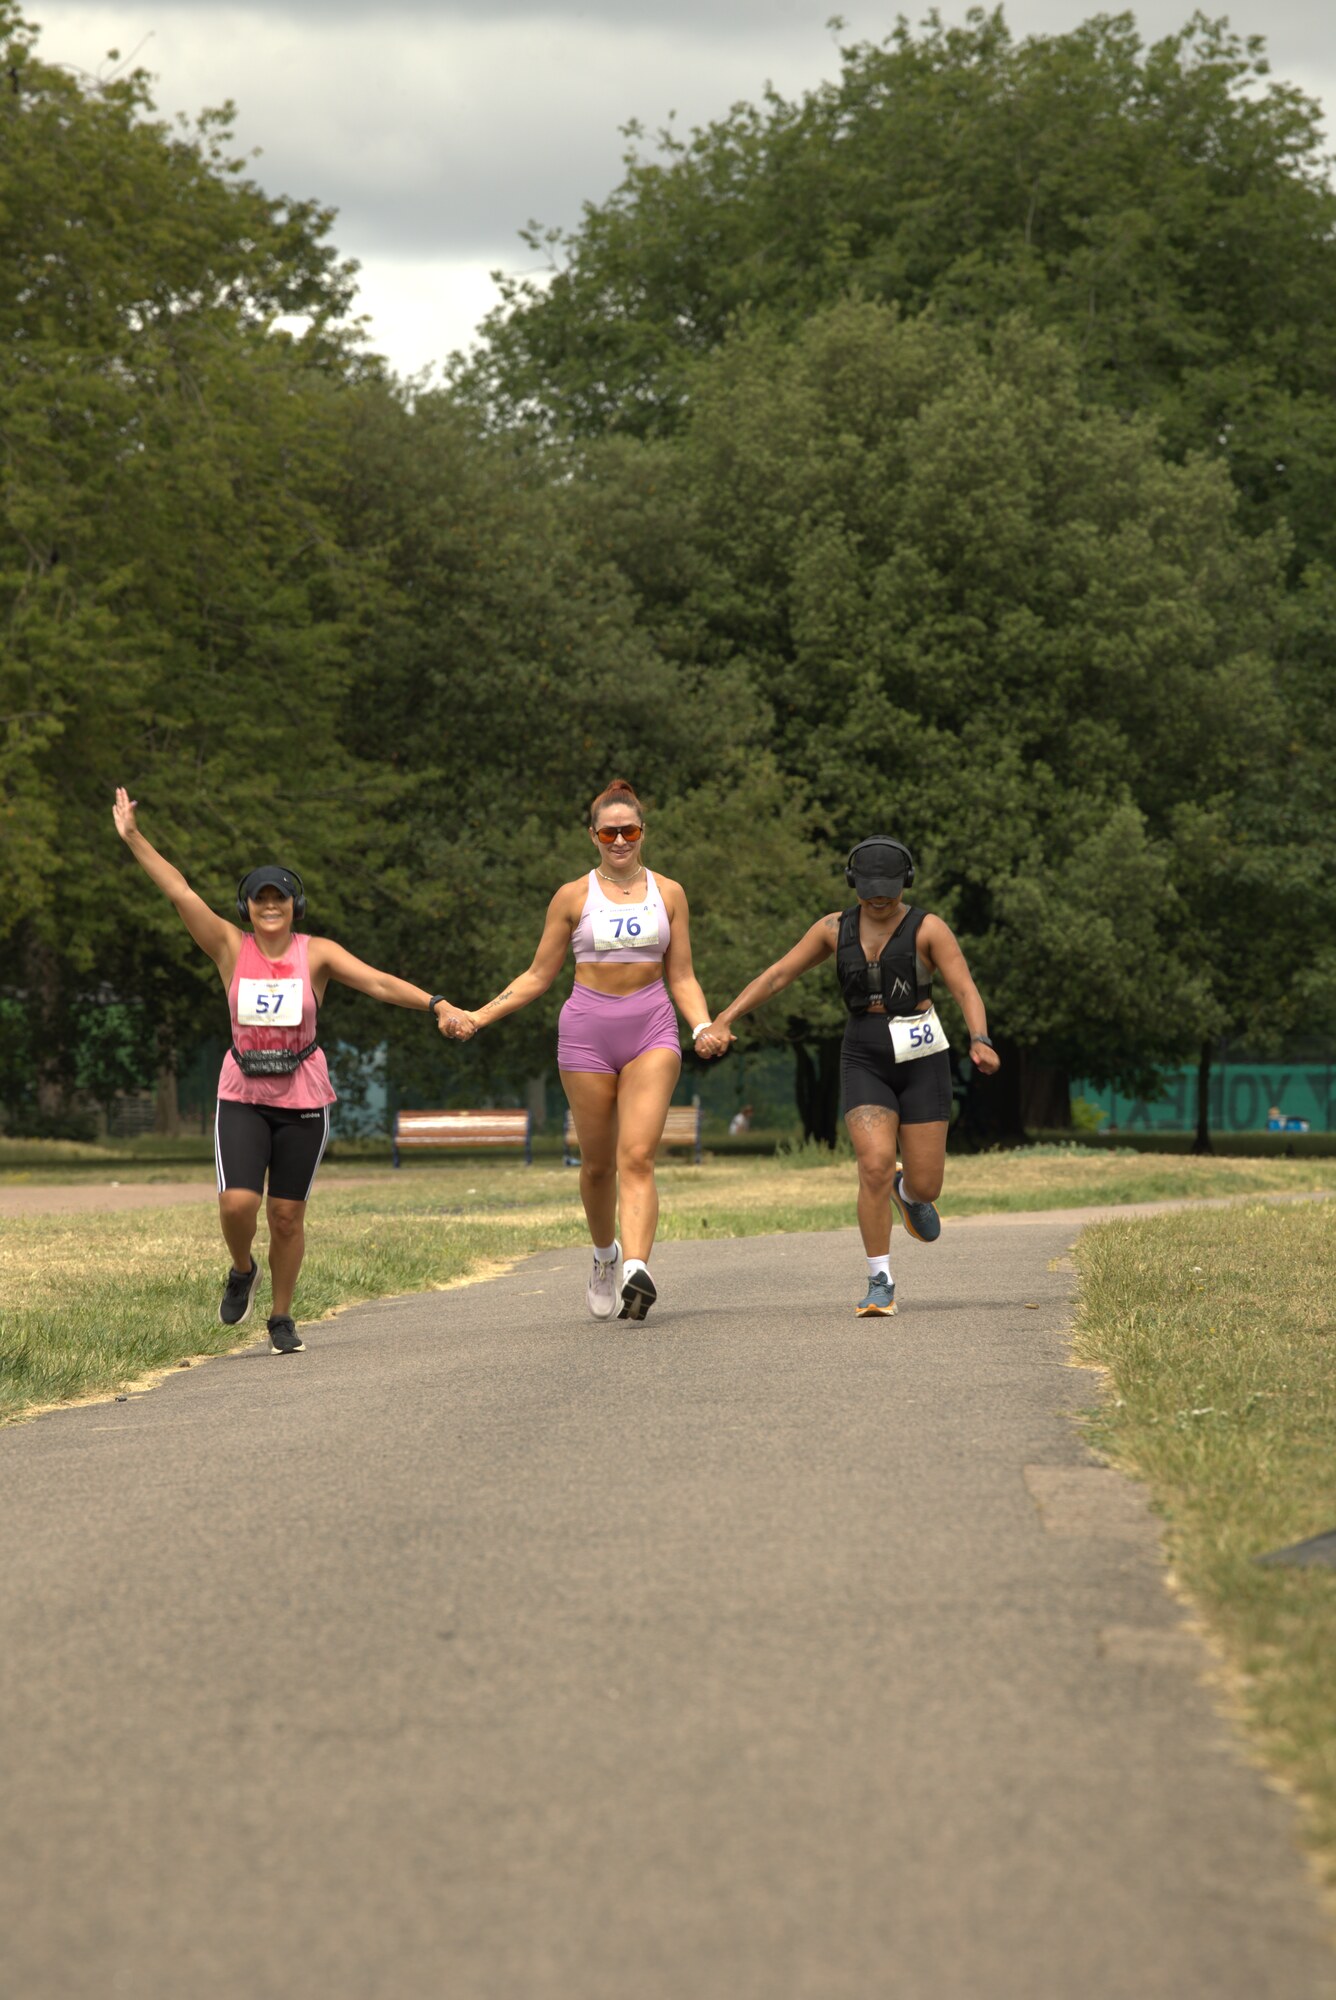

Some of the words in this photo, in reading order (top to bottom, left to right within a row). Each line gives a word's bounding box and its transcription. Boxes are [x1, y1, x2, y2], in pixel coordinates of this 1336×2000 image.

[609, 916, 642, 938] 76
[255, 994, 284, 1014] 57
[909, 1024, 934, 1048] 58
